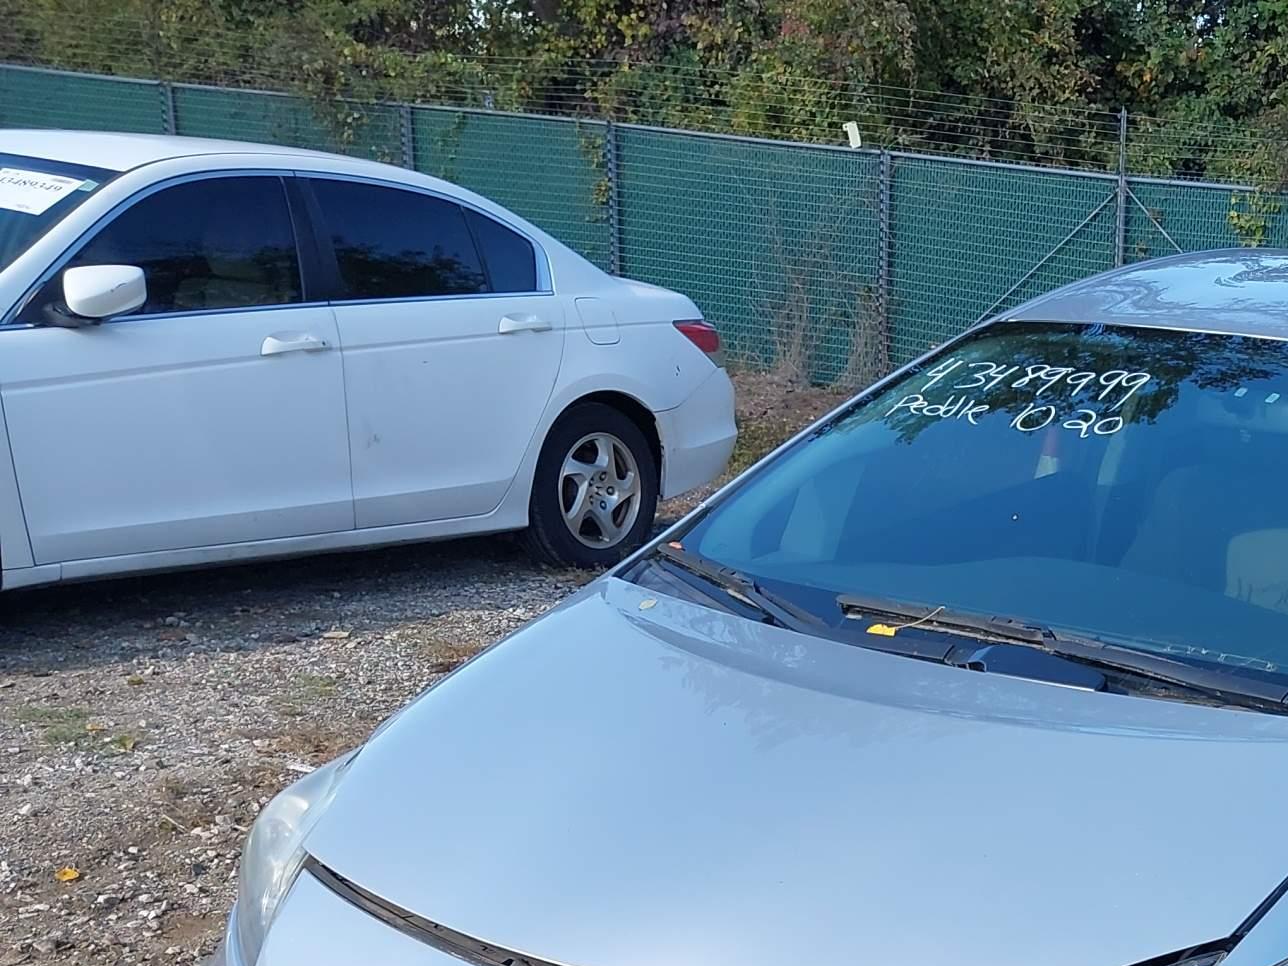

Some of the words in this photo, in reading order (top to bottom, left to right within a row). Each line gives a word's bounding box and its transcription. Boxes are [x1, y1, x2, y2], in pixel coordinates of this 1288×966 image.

[921, 358, 1151, 412] 43489999
[1009, 403, 1055, 431] 10
[1063, 410, 1124, 438] 20
